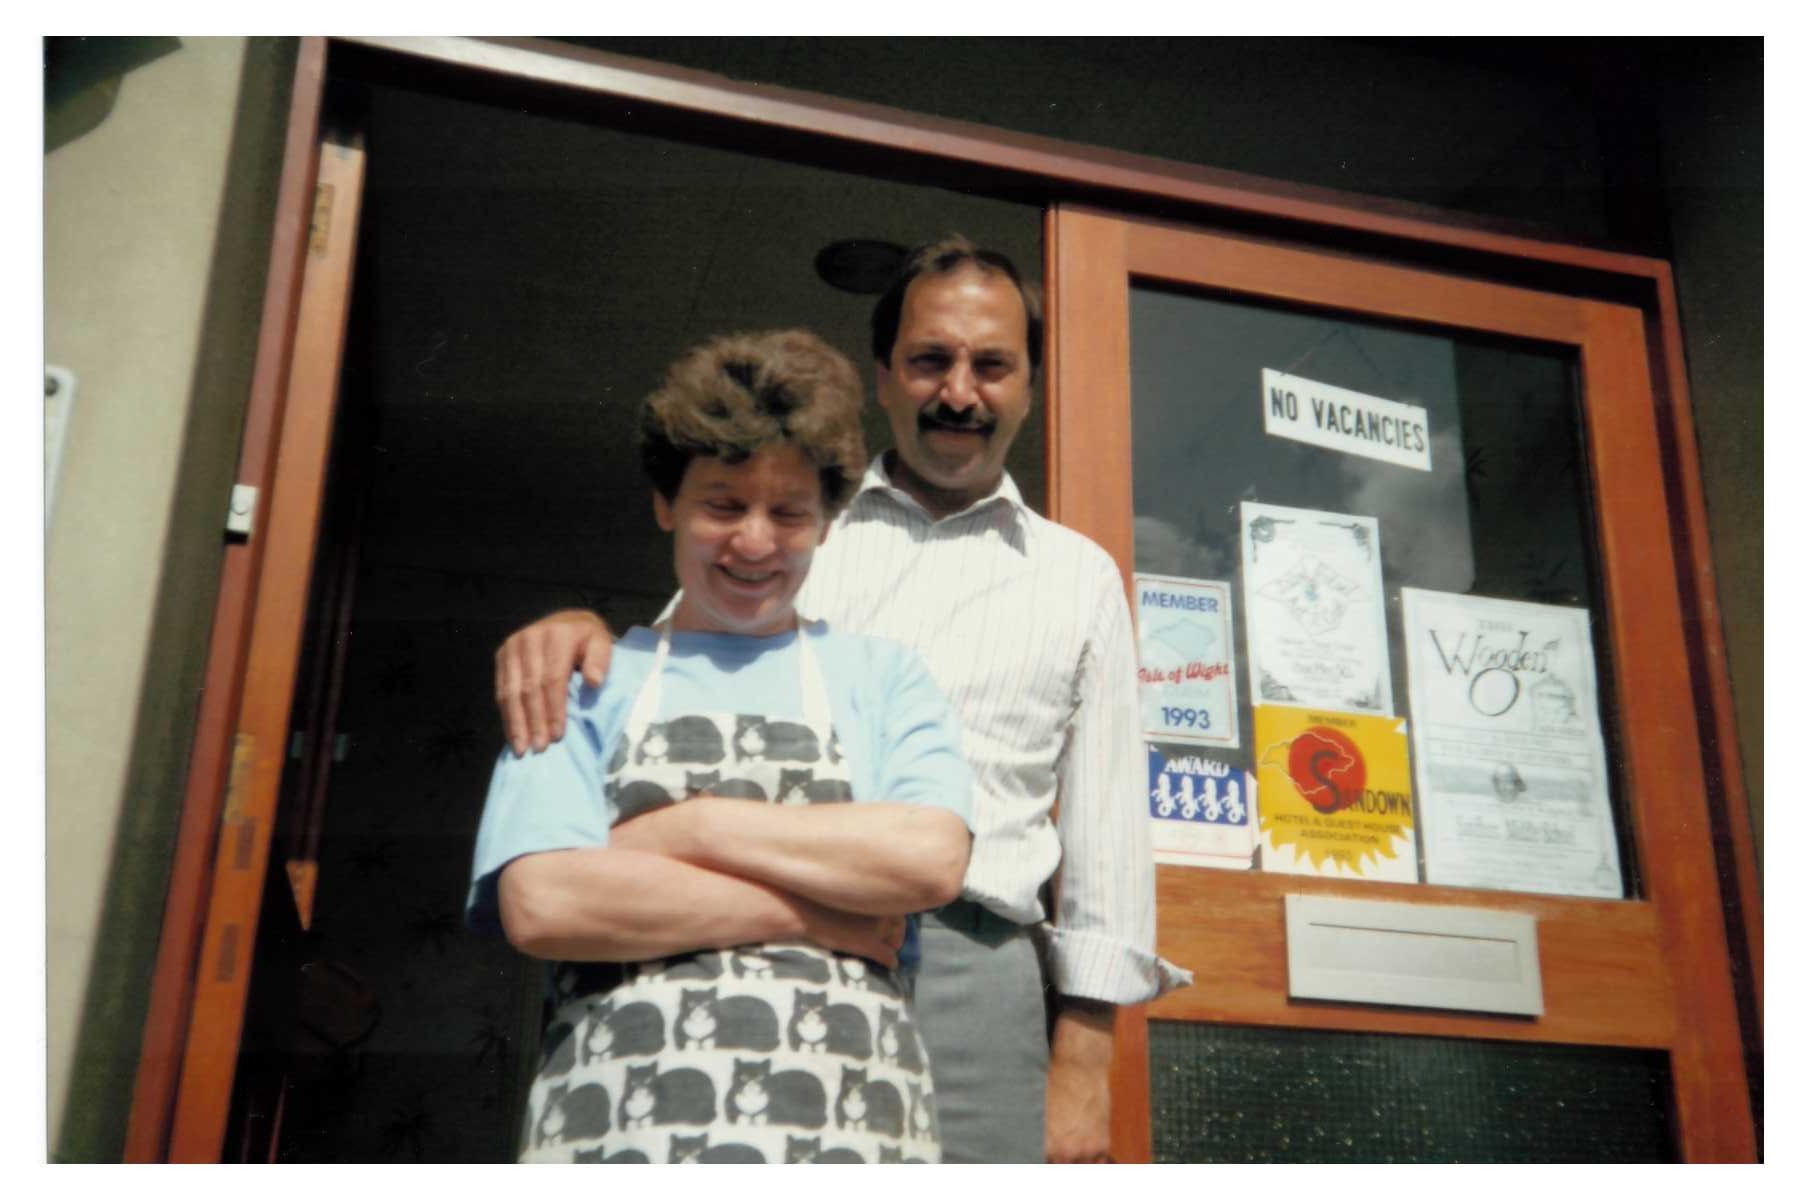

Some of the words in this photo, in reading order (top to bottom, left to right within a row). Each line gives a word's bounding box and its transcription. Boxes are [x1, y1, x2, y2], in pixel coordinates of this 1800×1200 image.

[1271, 387, 1298, 421] NO
[1311, 398, 1424, 452] VACANCIES
[1142, 591, 1219, 613] MEMBER
[1428, 629, 1548, 676] Wooden
[1168, 666, 1182, 684] of
[1185, 660, 1229, 681] Wight
[1161, 706, 1211, 730] 1993
[1307, 714, 1356, 727] MEMBER
[1274, 813, 1310, 825] HOTEL
[1324, 817, 1360, 831] GUEST
[1364, 821, 1401, 833] HOUSE
[1300, 828, 1379, 844] ASSOCIATION
